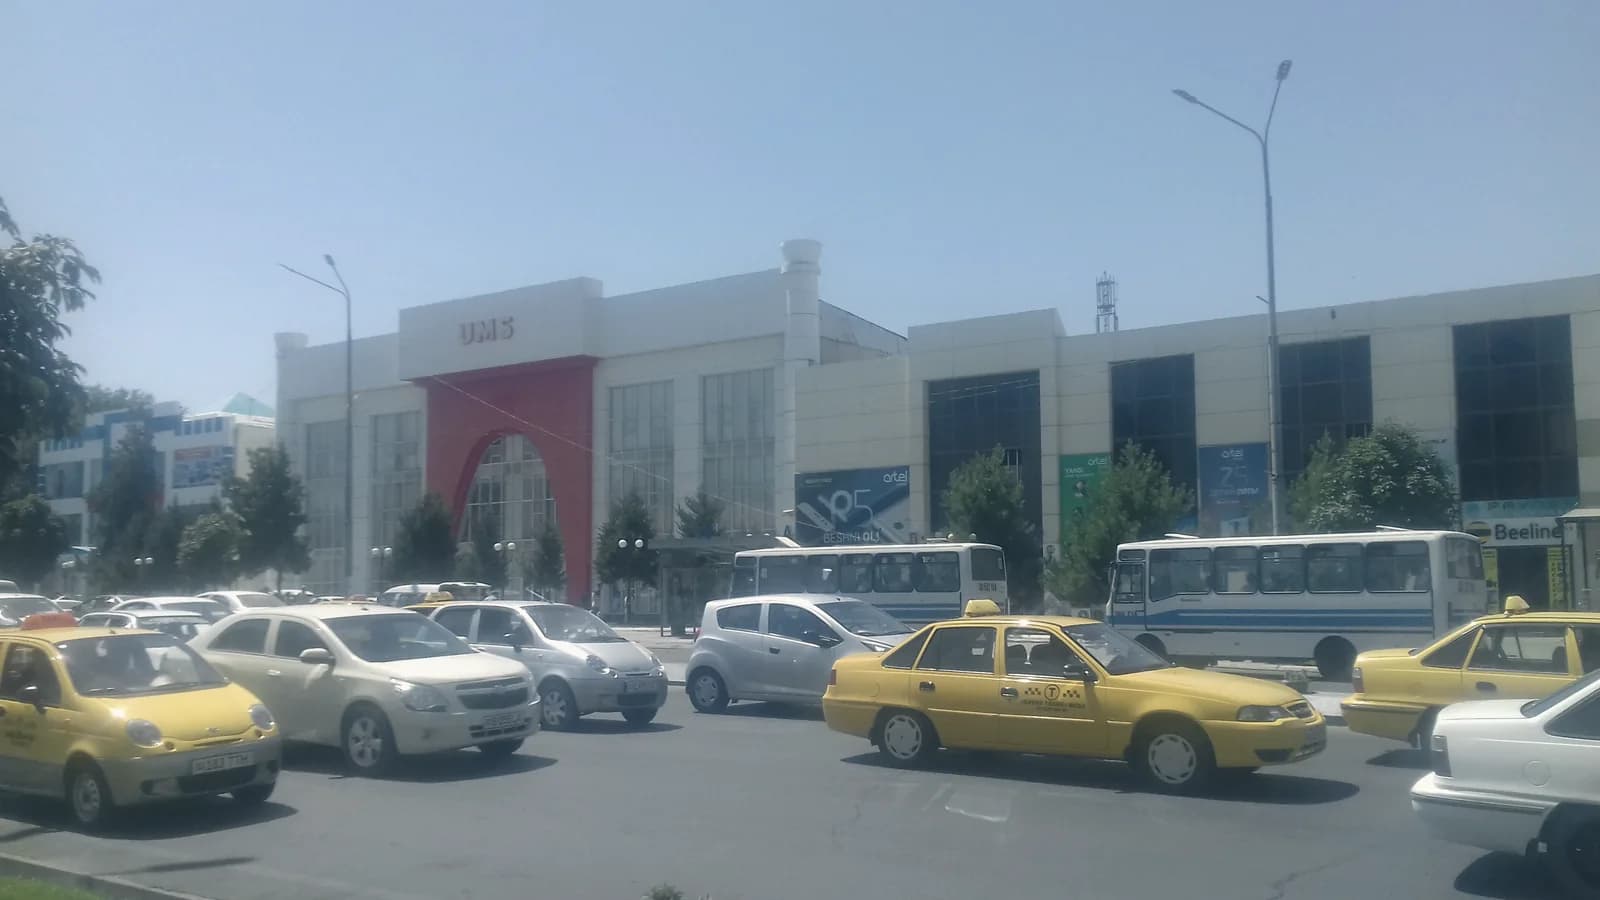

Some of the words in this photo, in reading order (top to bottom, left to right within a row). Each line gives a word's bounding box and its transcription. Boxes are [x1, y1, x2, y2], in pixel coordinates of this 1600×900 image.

[459, 316, 515, 346] UMS
[882, 470, 908, 486] artel
[1494, 523, 1562, 540] Beeline
